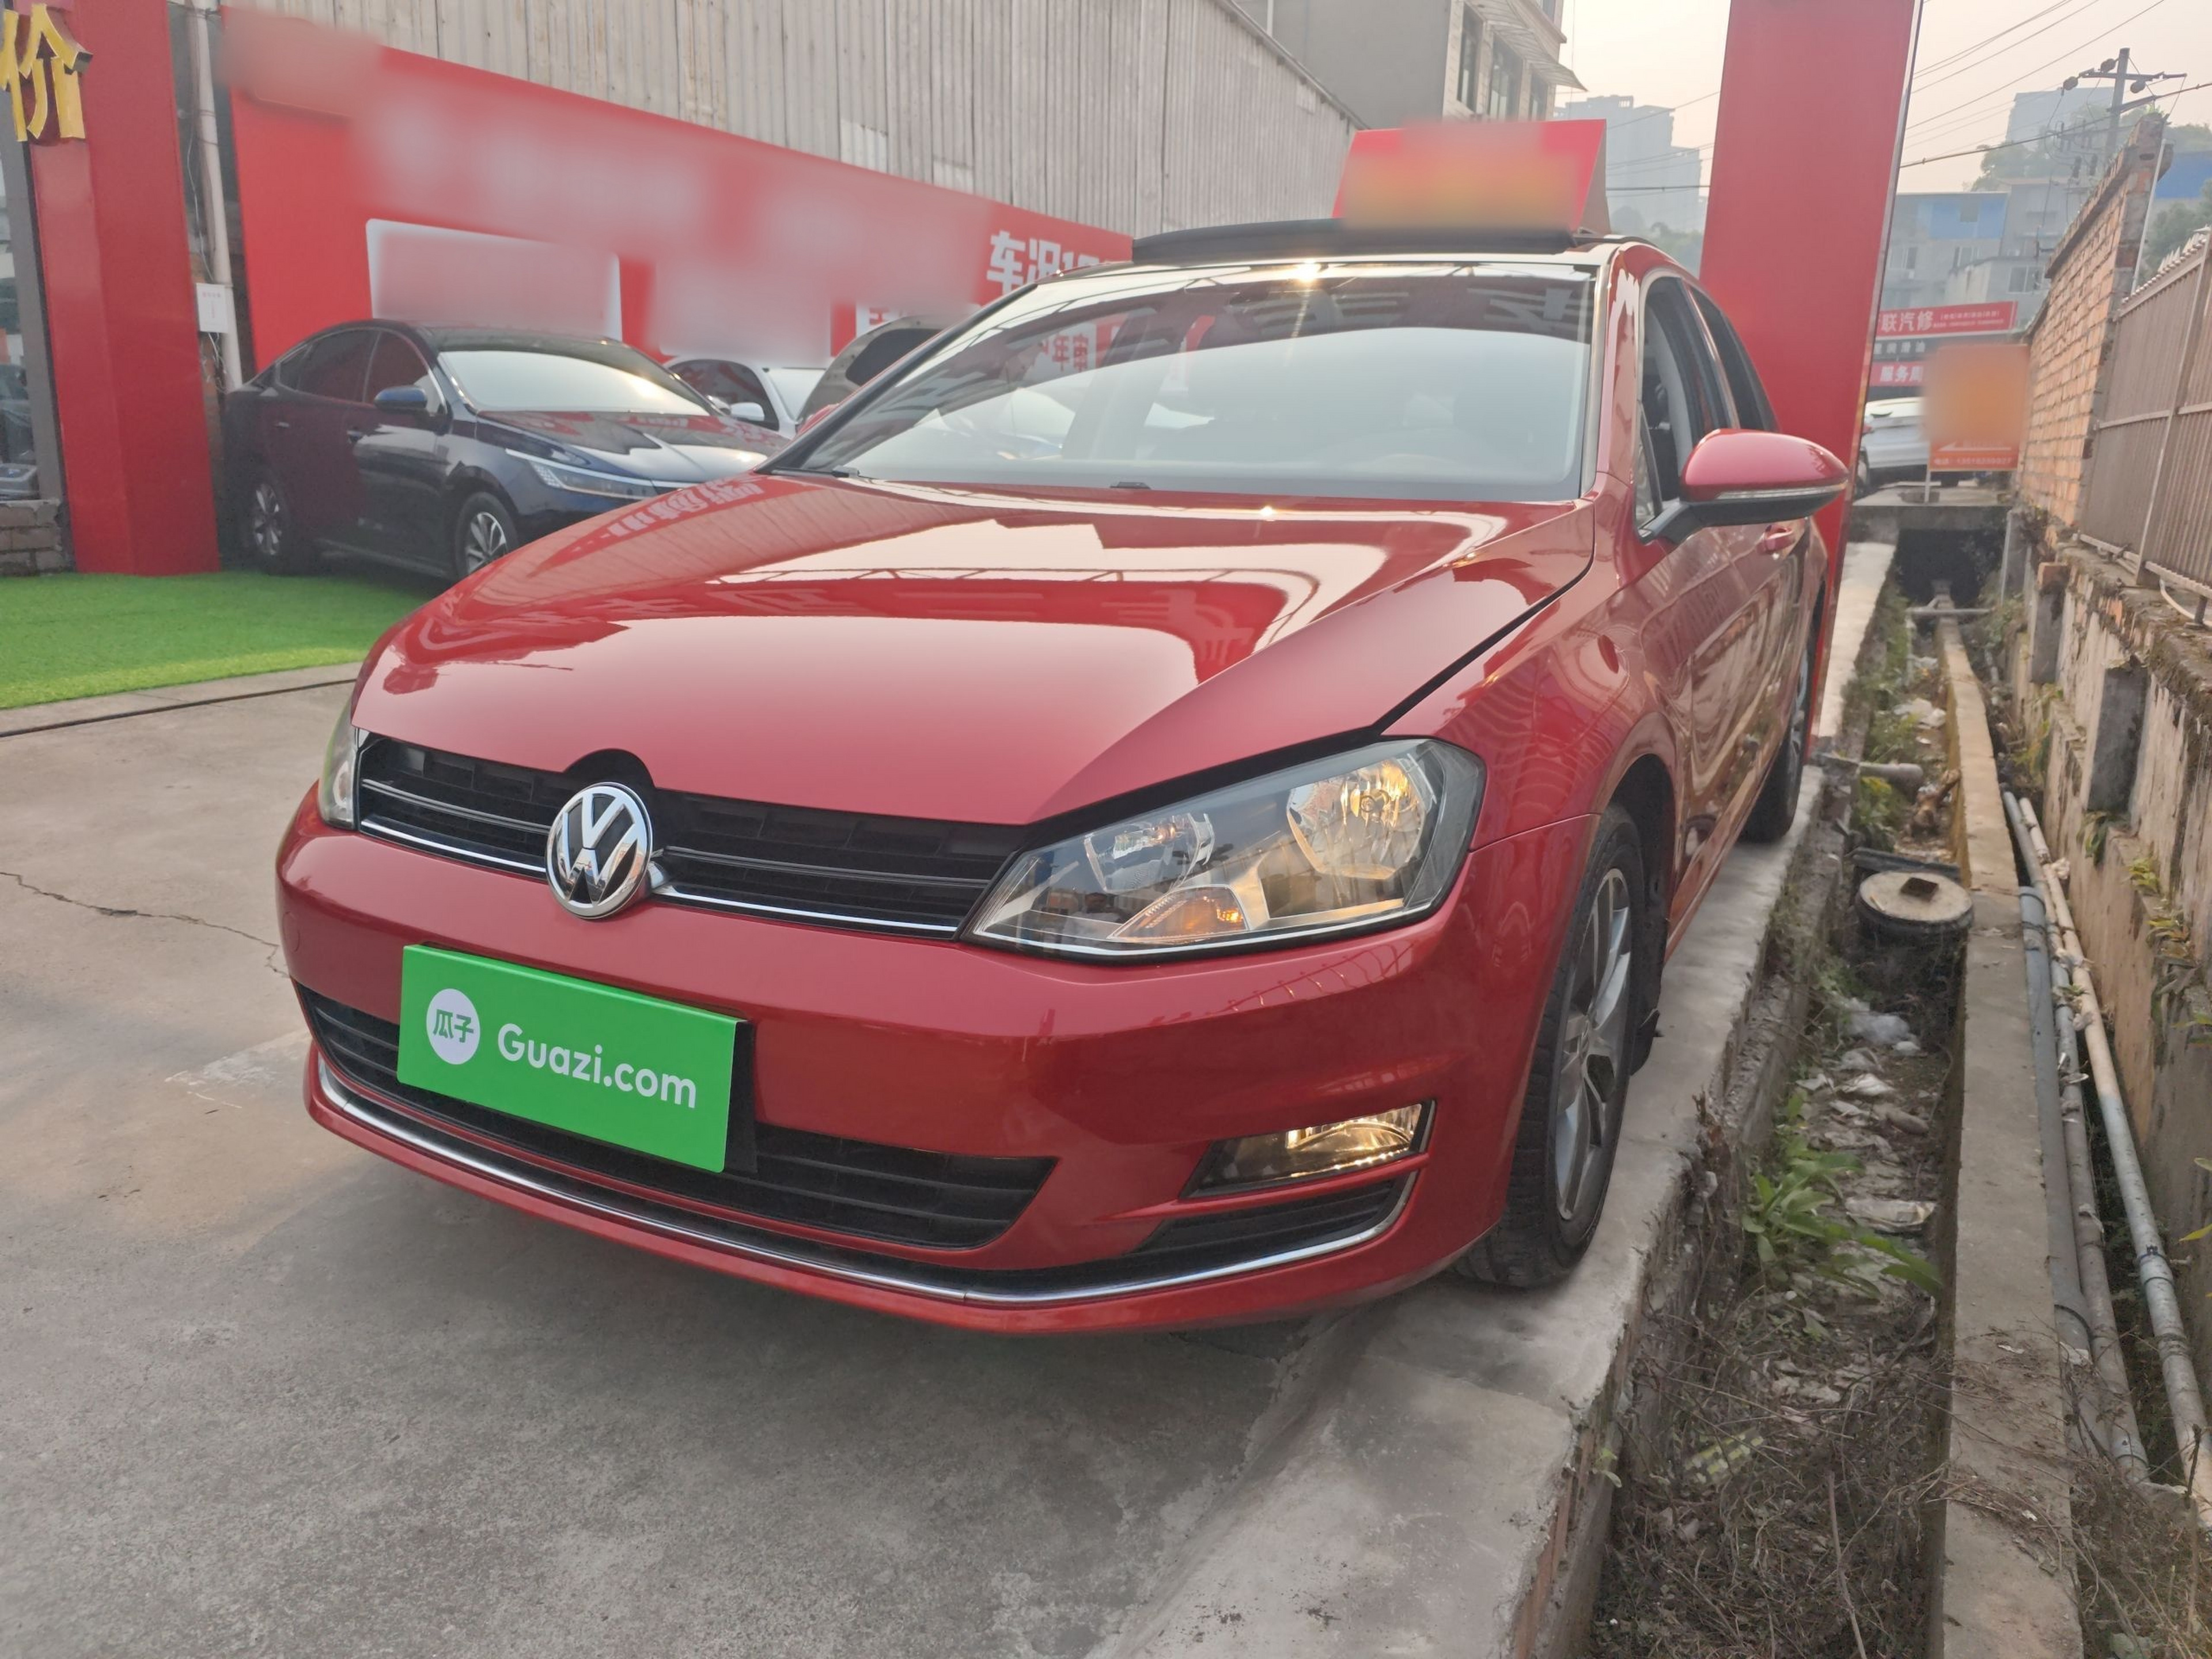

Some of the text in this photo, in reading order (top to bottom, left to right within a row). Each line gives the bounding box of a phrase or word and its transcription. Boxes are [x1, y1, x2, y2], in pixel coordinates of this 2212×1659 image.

[1878, 311, 1933, 332] 联汽修
[432, 1009, 696, 1108] 瓜子 Guazi.com
